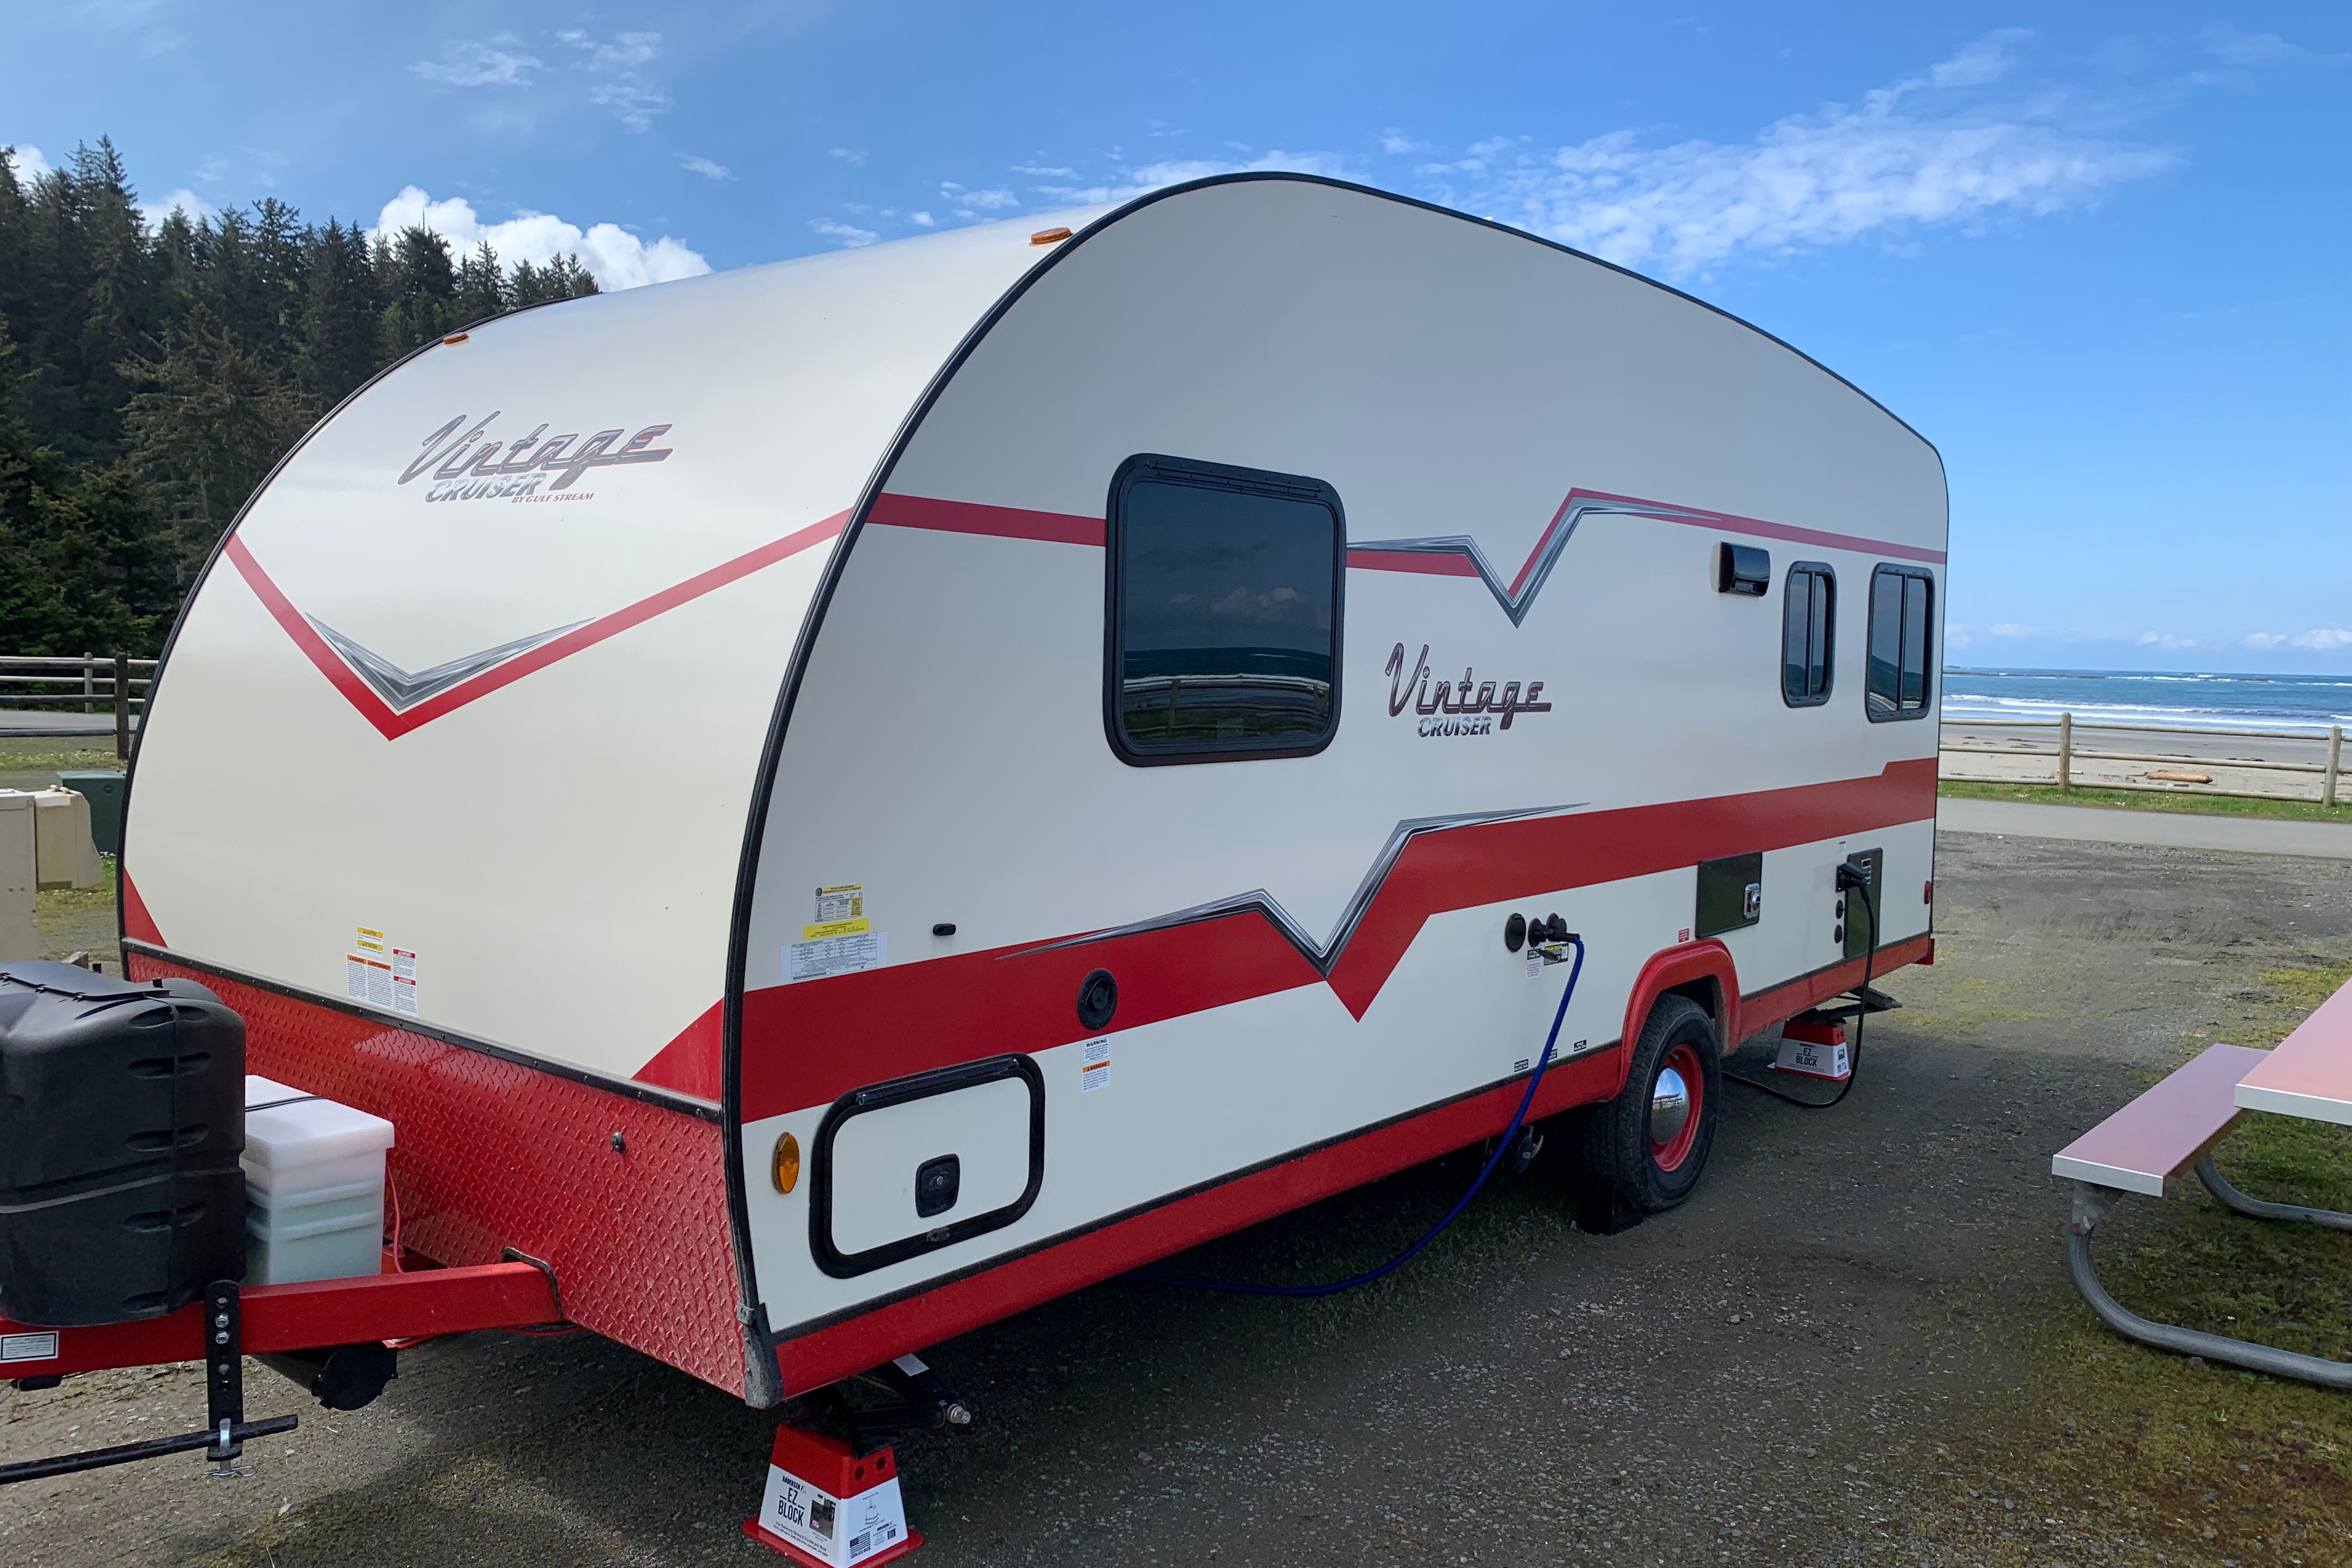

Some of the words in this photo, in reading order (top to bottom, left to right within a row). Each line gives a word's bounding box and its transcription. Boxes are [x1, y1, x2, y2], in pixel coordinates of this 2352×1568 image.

[397, 411, 673, 490] Vintage
[425, 473, 547, 503] CRUISER
[511, 495, 525, 503] BY
[526, 494, 552, 502] GULF
[552, 492, 594, 502] STREAM
[1385, 642, 1552, 730] Vintage
[1418, 716, 1492, 737] CRUISER
[1086, 1038, 1107, 1047] WARNING
[1804, 1047, 1812, 1056] EZ
[1796, 1055, 1817, 1067] BLOCK
[788, 1487, 798, 1506] EZ
[778, 1499, 804, 1527] BLOCK
